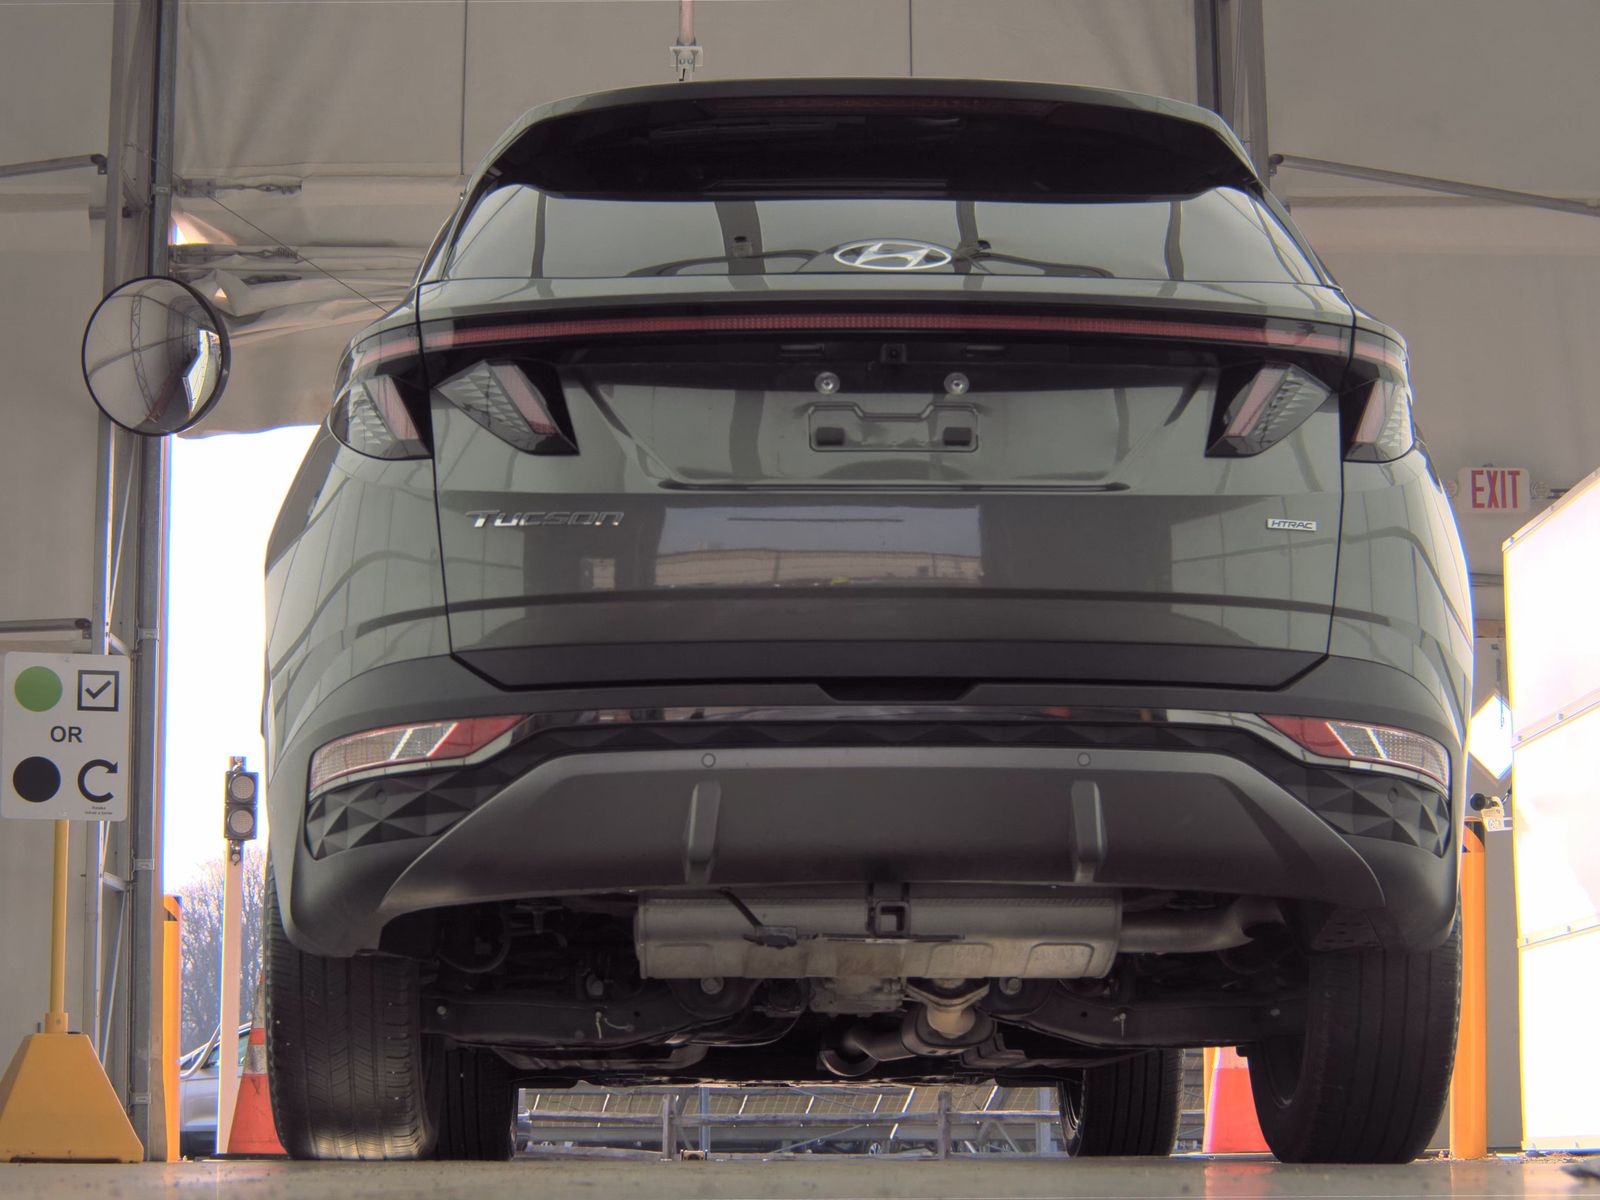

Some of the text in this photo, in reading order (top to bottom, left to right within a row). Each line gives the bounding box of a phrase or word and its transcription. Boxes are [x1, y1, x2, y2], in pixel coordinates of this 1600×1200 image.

[1471, 470, 1520, 508] EXIT
[1270, 519, 1314, 530] HTRAC
[50, 725, 83, 743] OR
